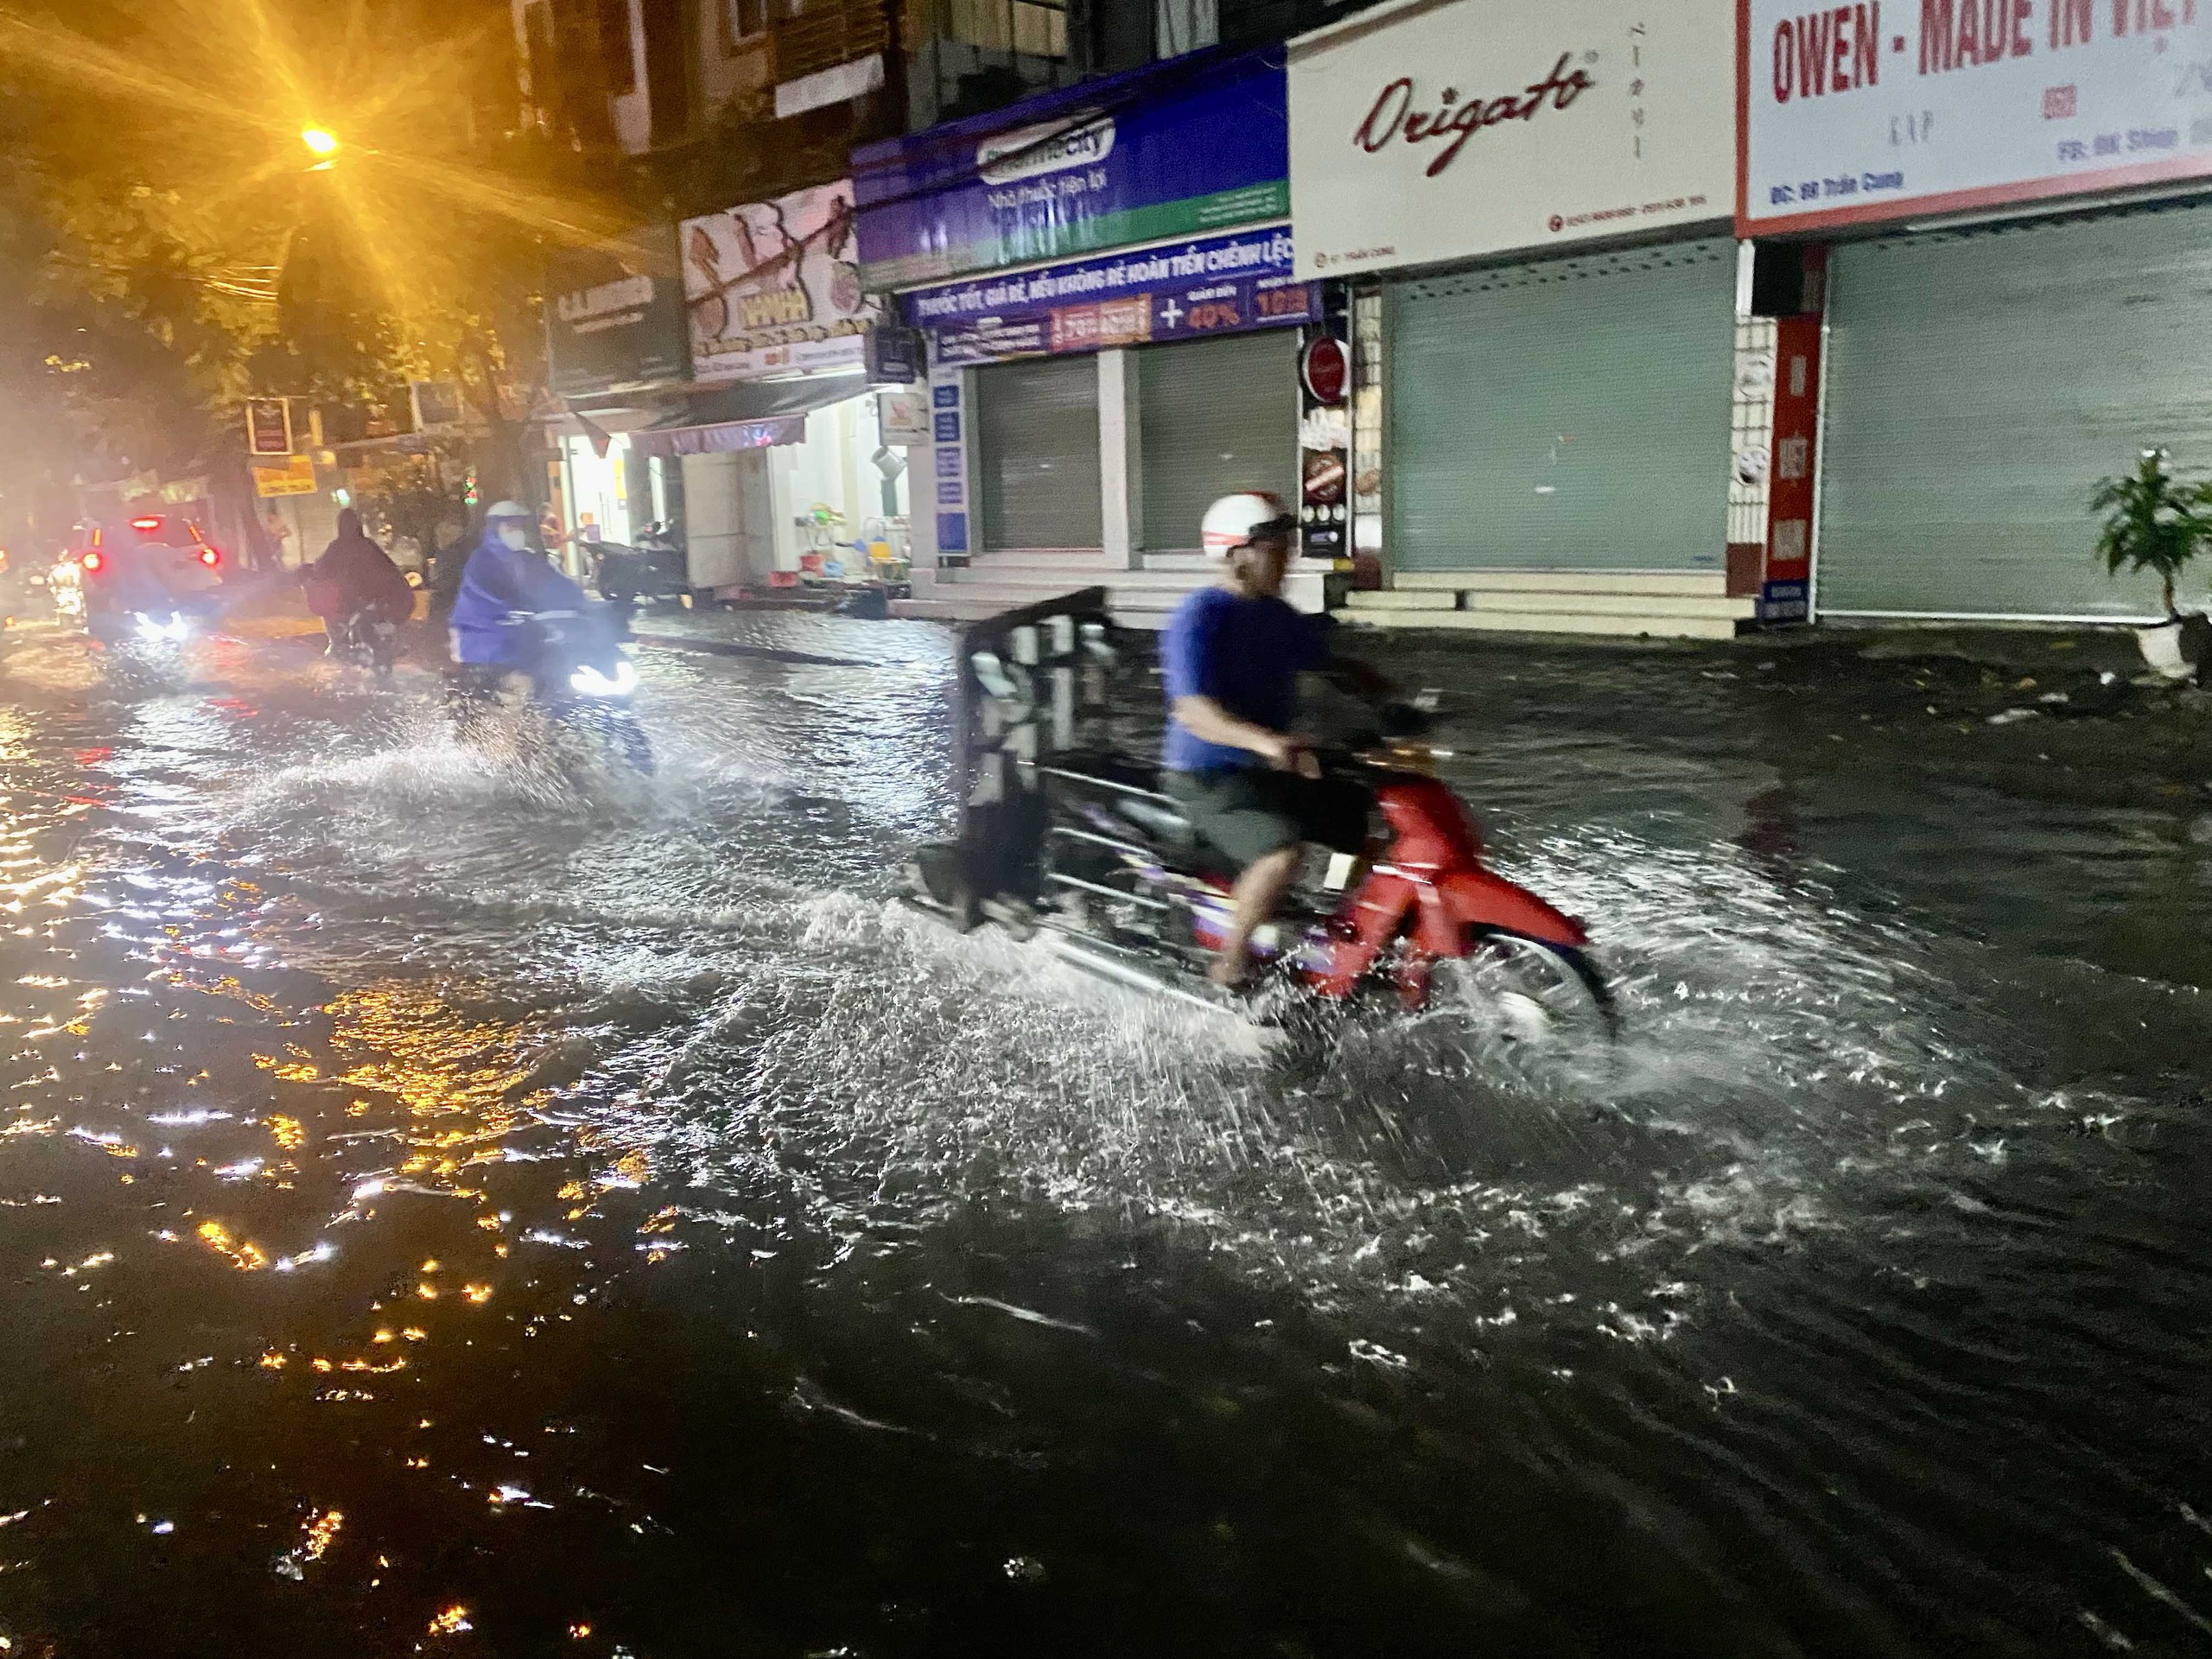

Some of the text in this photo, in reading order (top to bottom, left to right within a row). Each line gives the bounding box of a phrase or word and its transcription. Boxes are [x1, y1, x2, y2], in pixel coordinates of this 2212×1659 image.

[1773, 0, 1879, 104] OWEN
[1919, 0, 2032, 75] MADE
[1263, 232, 1293, 267] LỆC
